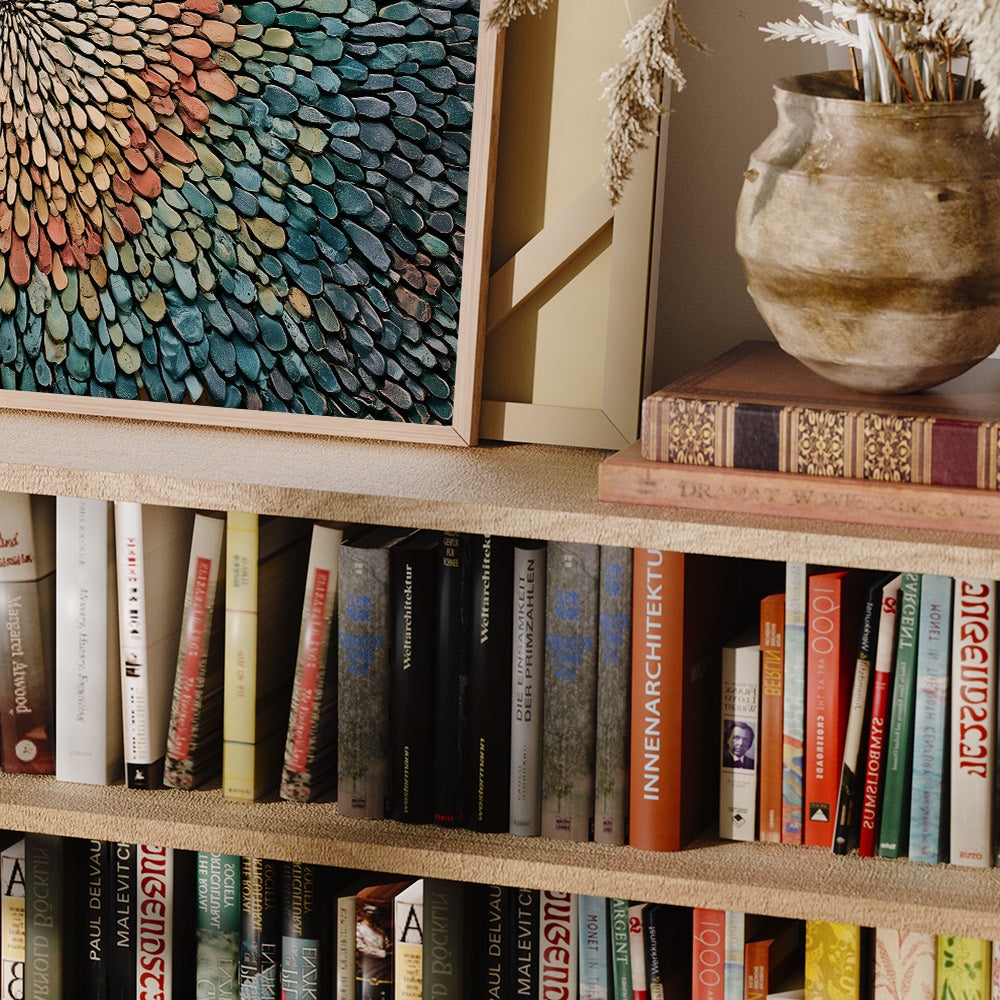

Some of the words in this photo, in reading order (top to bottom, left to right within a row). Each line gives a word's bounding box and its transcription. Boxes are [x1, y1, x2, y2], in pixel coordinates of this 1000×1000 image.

[6, 594, 24, 657] Margaret
[402, 564, 413, 671] Weltarchitektur
[516, 575, 526, 684] EINSAMKEIT
[524, 559, 536, 680] PRIMZAHLEN
[12, 660, 33, 715] Atwood
[515, 691, 524, 722] DIE
[523, 686, 533, 723] DER
[90, 916, 102, 961] PAUL
[586, 914, 599, 952] MONET
[649, 925, 661, 975] Werkkunst
[693, 921, 721, 987] 1900
